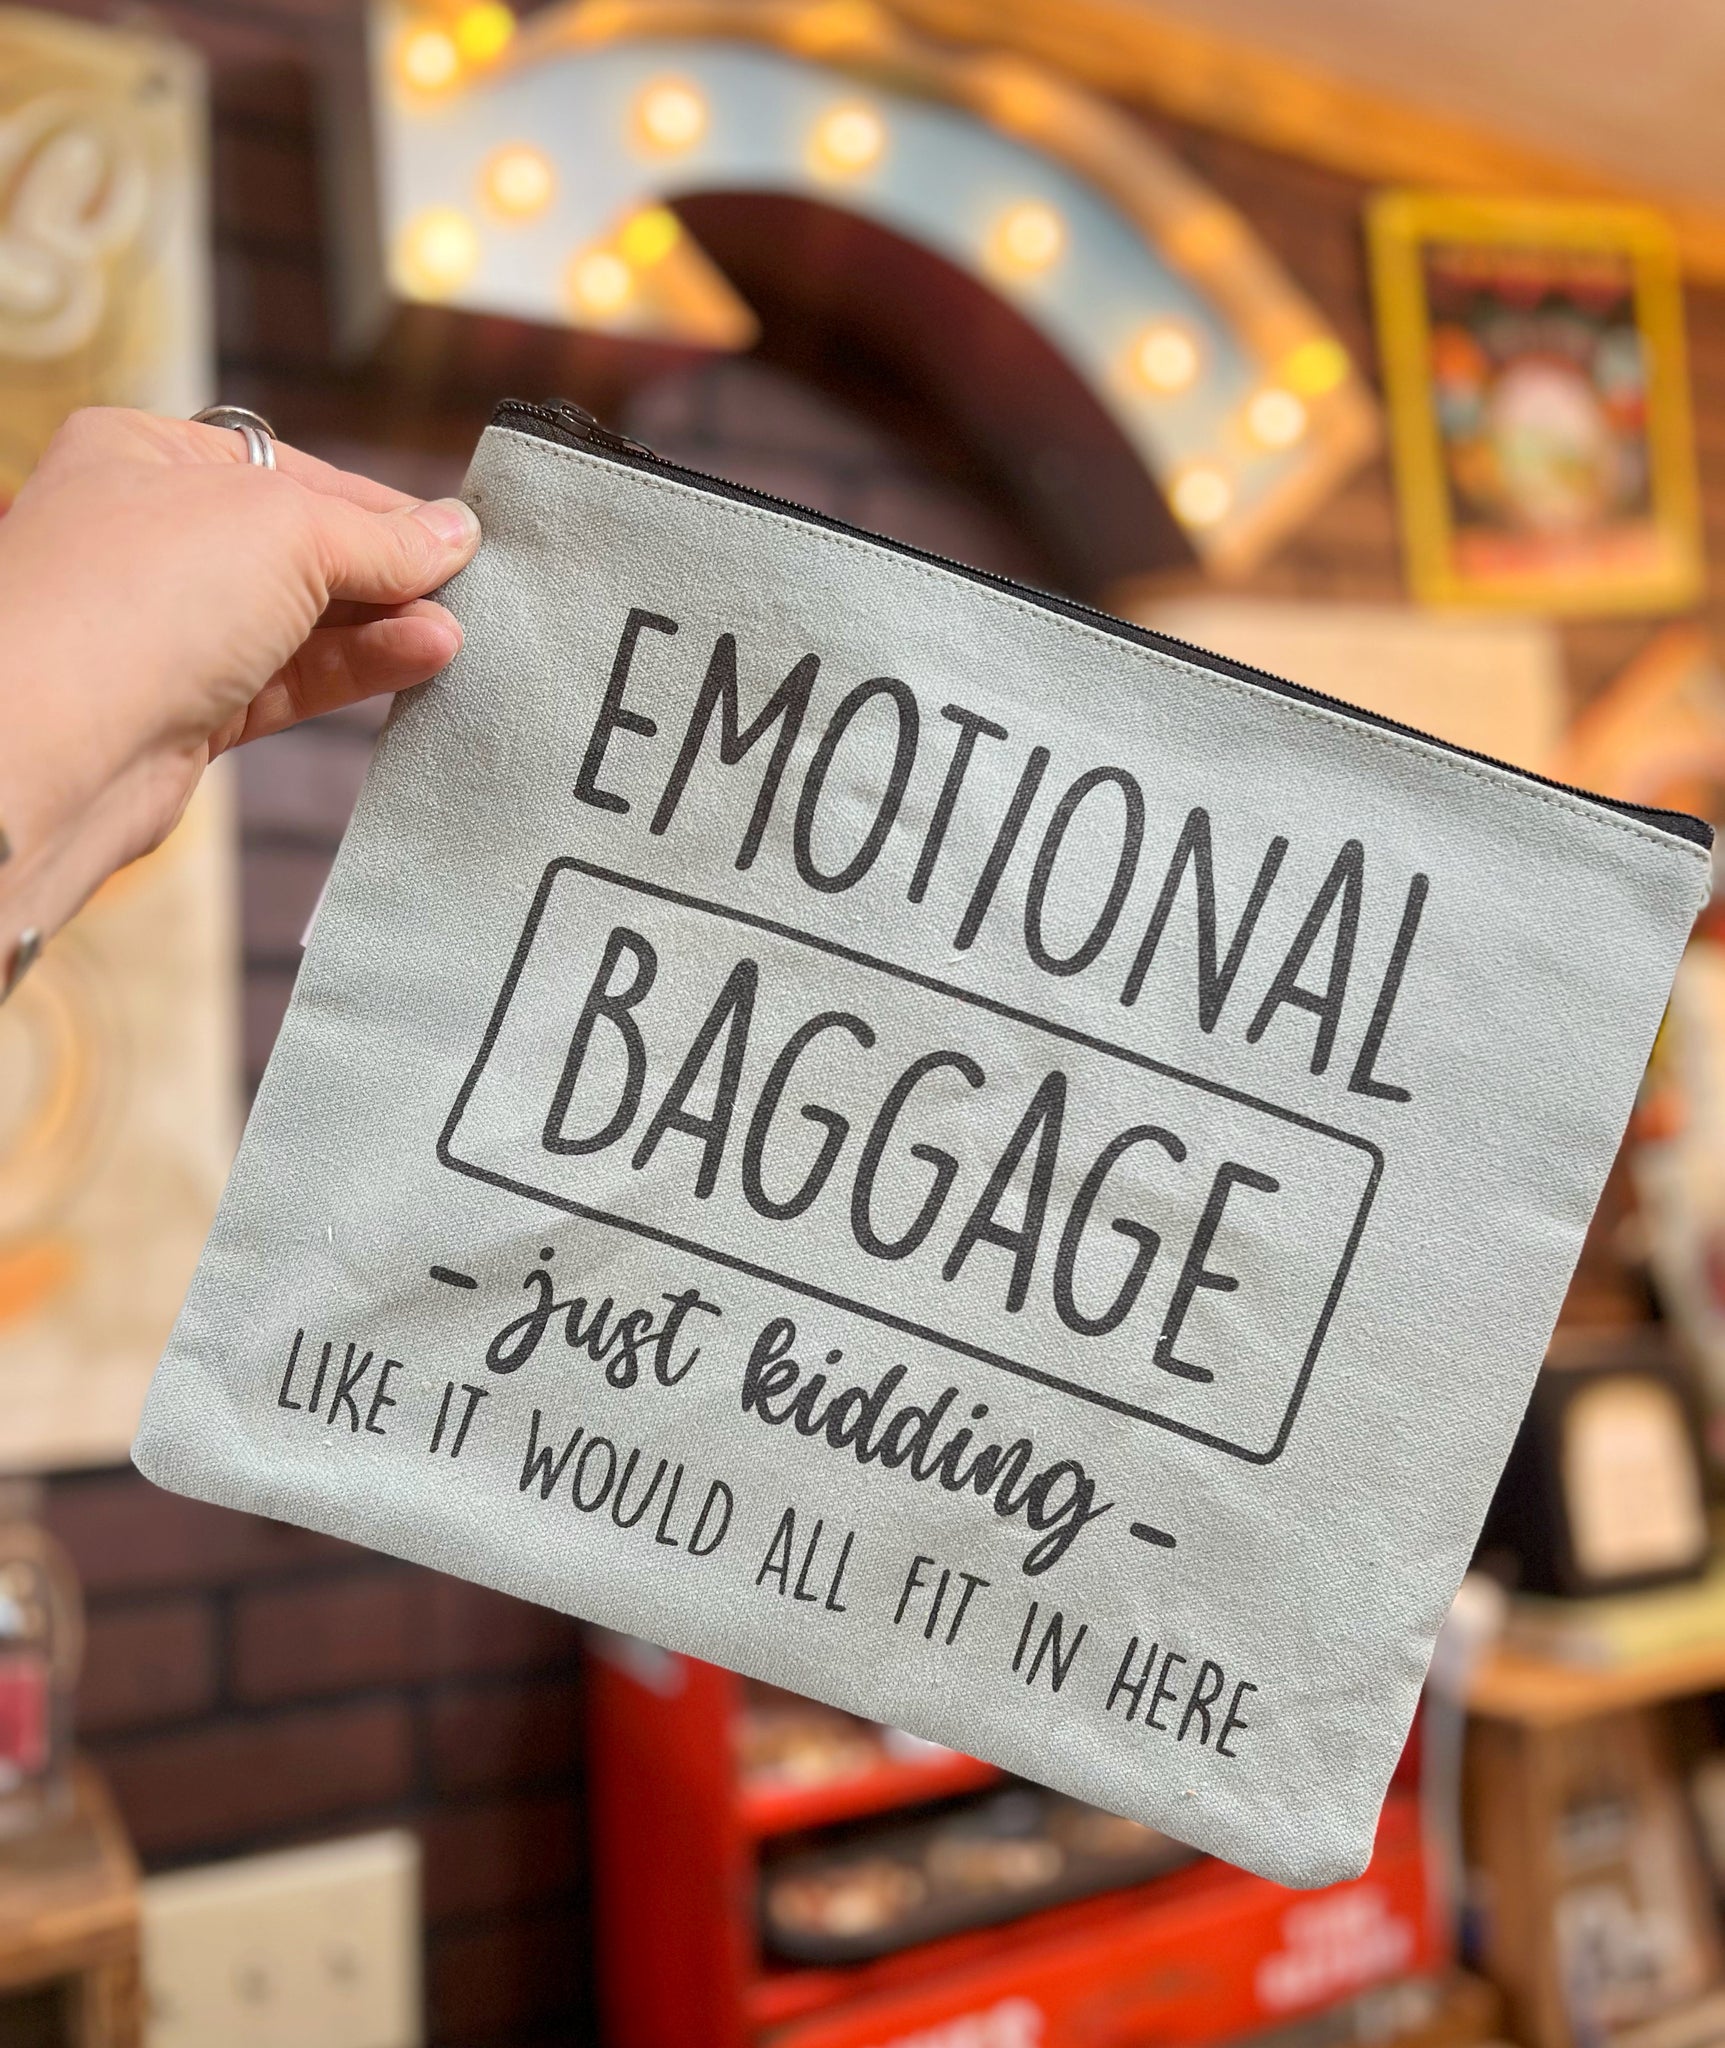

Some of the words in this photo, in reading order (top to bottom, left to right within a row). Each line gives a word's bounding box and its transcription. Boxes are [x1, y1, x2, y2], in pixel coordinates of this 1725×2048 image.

[572, 607, 1431, 1103] EMOTIONAL
[541, 926, 1280, 1384] BAGGAGE
[278, 1327, 404, 1435] LIKE
[430, 1380, 490, 1459] IT
[520, 1408, 734, 1557] WOULD
[756, 1507, 855, 1613] ALL
[893, 1555, 992, 1646] FIT
[1011, 1601, 1089, 1693] IN
[1105, 1636, 1260, 1758] HERE
[485, 1246, 723, 1391] just
[741, 1317, 1116, 1577] kidding
